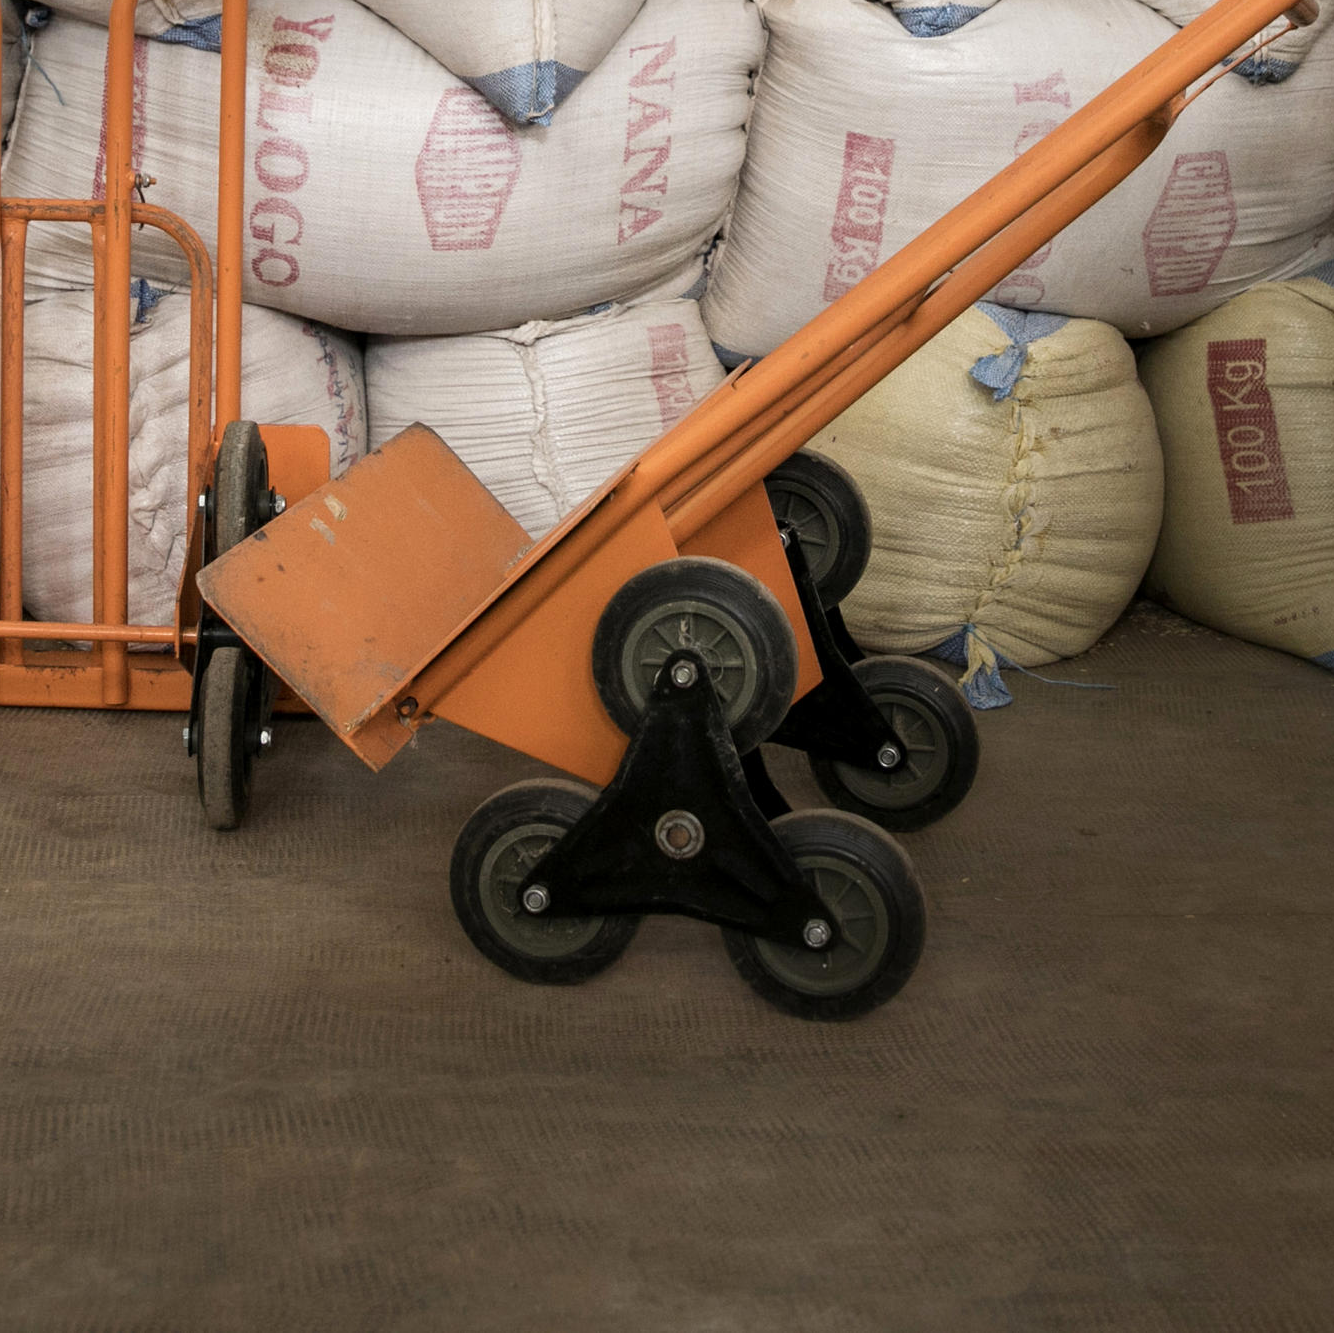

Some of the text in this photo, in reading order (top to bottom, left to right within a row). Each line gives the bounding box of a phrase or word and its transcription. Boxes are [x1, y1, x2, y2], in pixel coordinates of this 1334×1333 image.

[250, 14, 335, 289] YOLOGO
[417, 94, 520, 248] CHAMPION
[617, 36, 678, 245] NANA
[832, 168, 884, 289] 100 Kg
[1146, 155, 1235, 294] CHAMPION
[1224, 359, 1266, 493] 100 Kg
